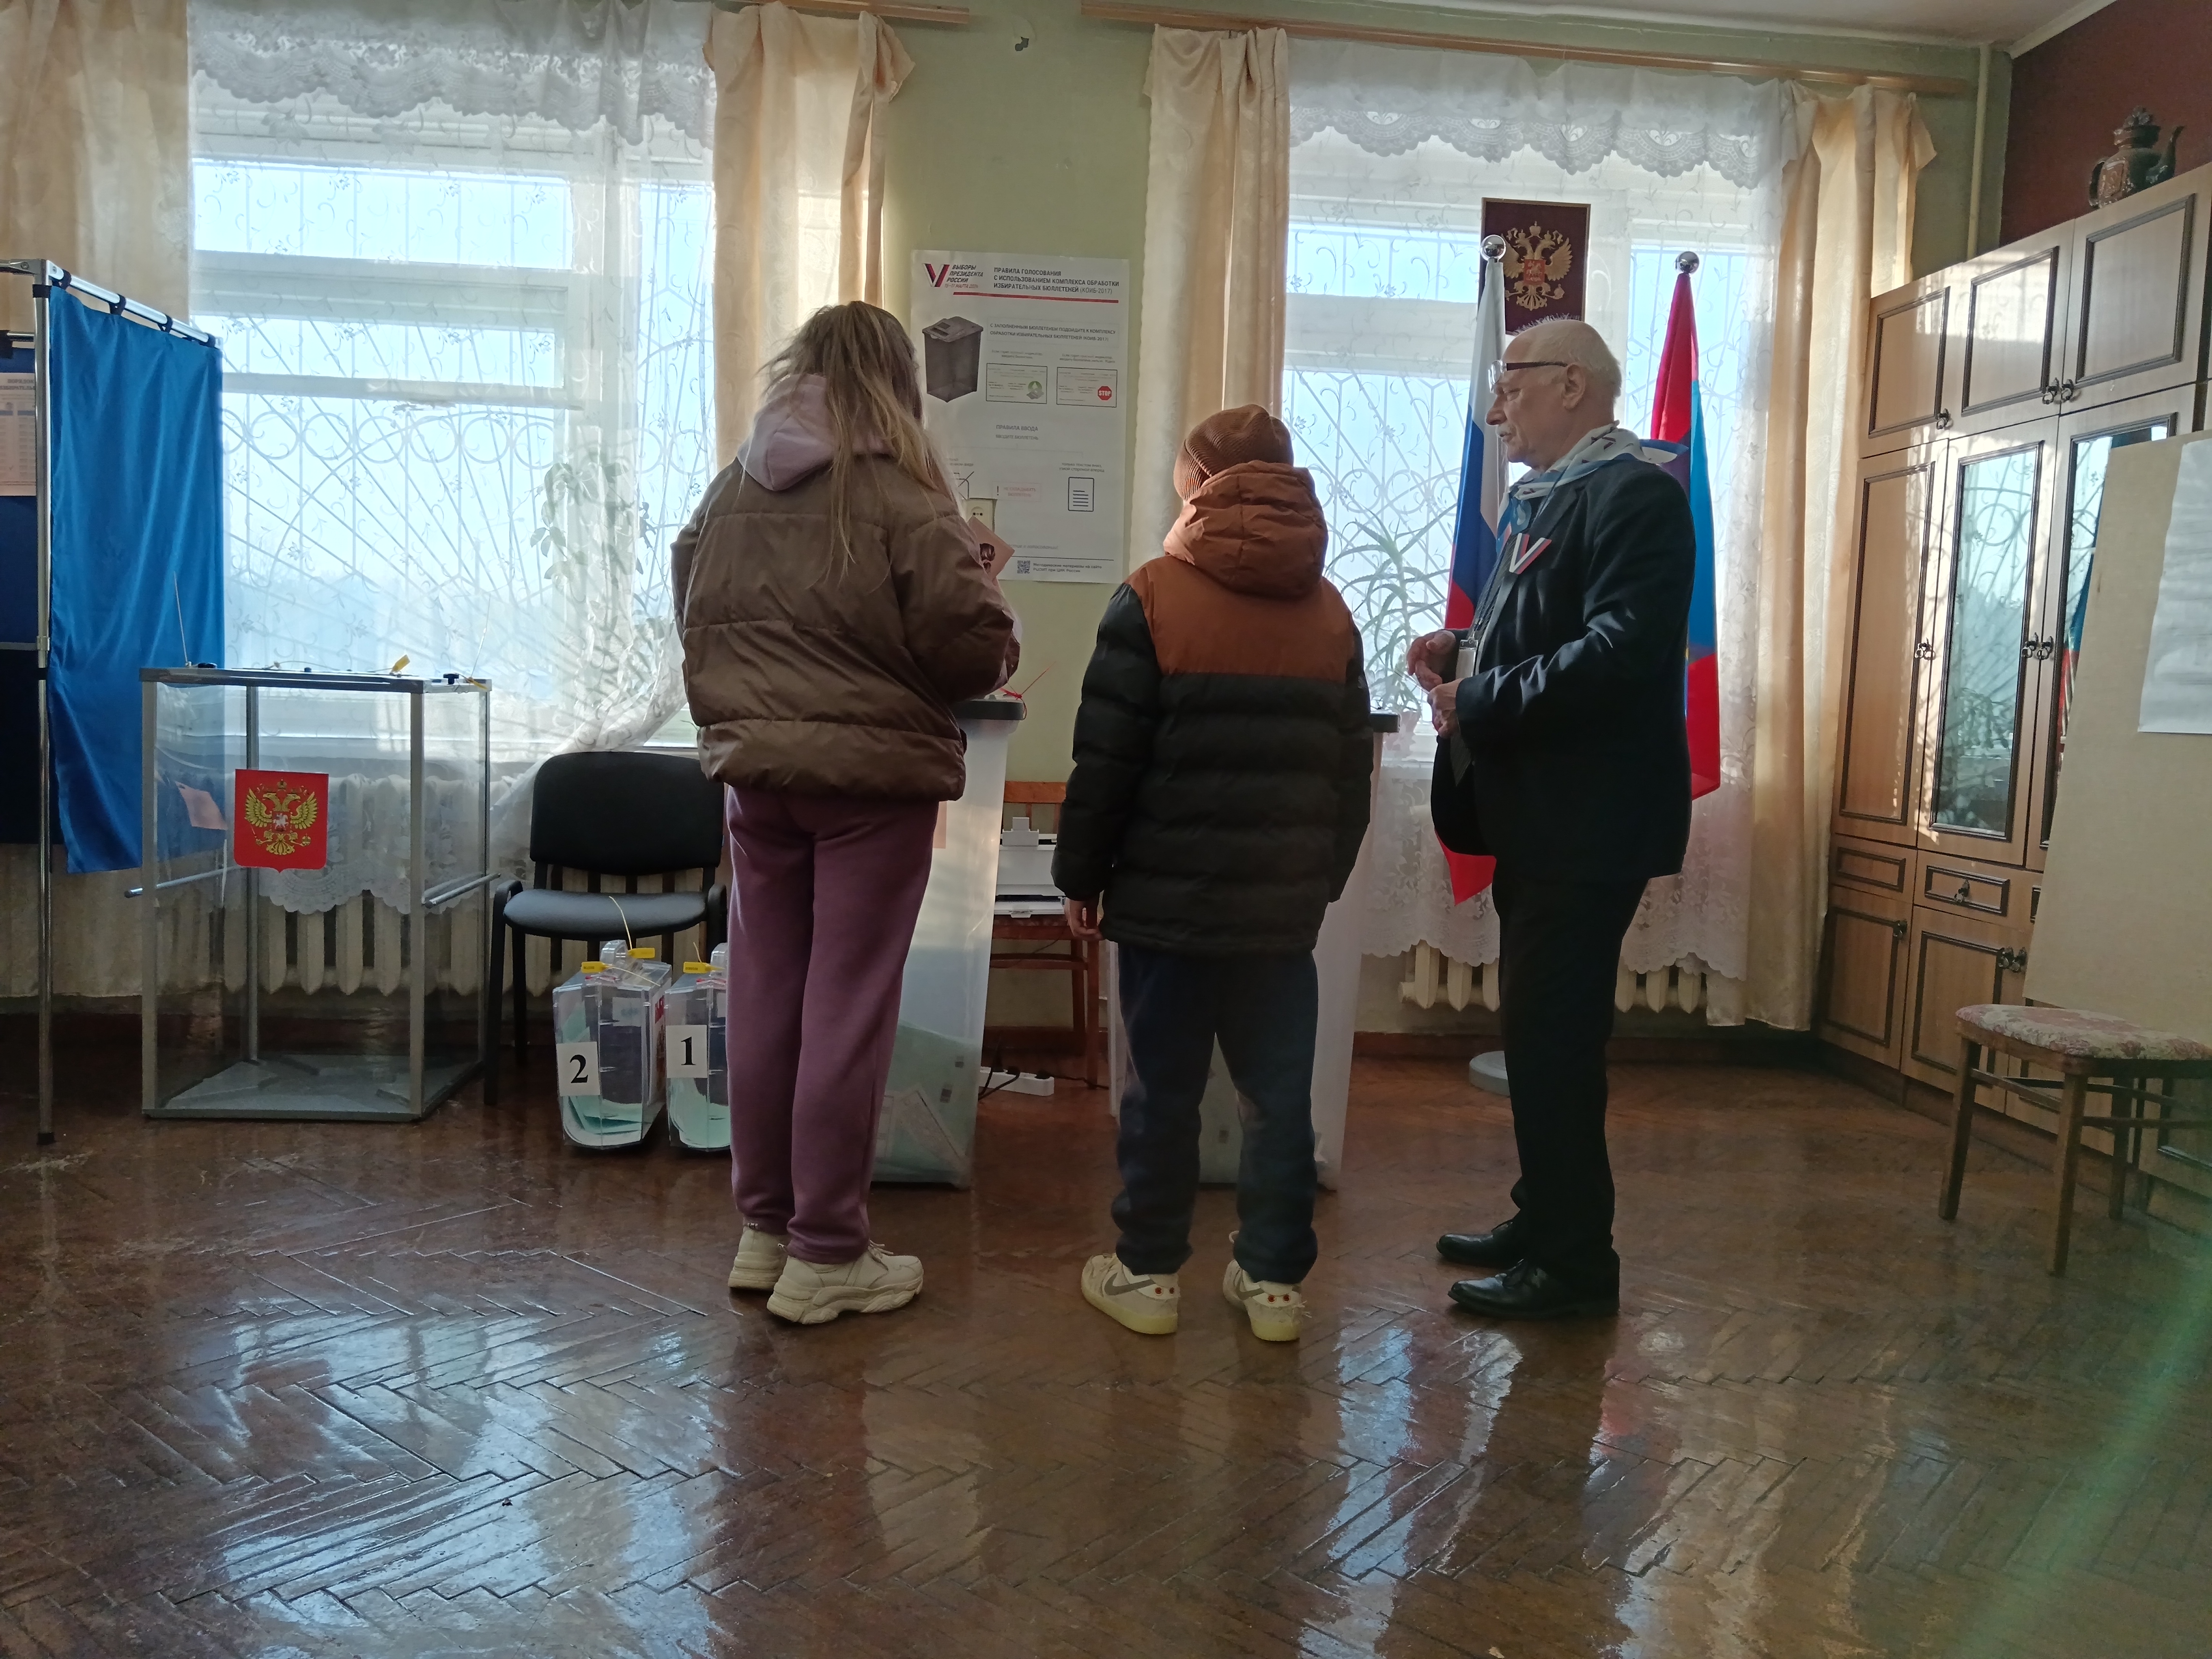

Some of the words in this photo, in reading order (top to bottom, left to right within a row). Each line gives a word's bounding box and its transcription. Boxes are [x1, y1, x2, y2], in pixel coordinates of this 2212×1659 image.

[999, 275, 1051, 283] ИСПОЛЬЗОВАНИЕМ
[681, 1036, 696, 1066] 1
[569, 1054, 589, 1083] 2
